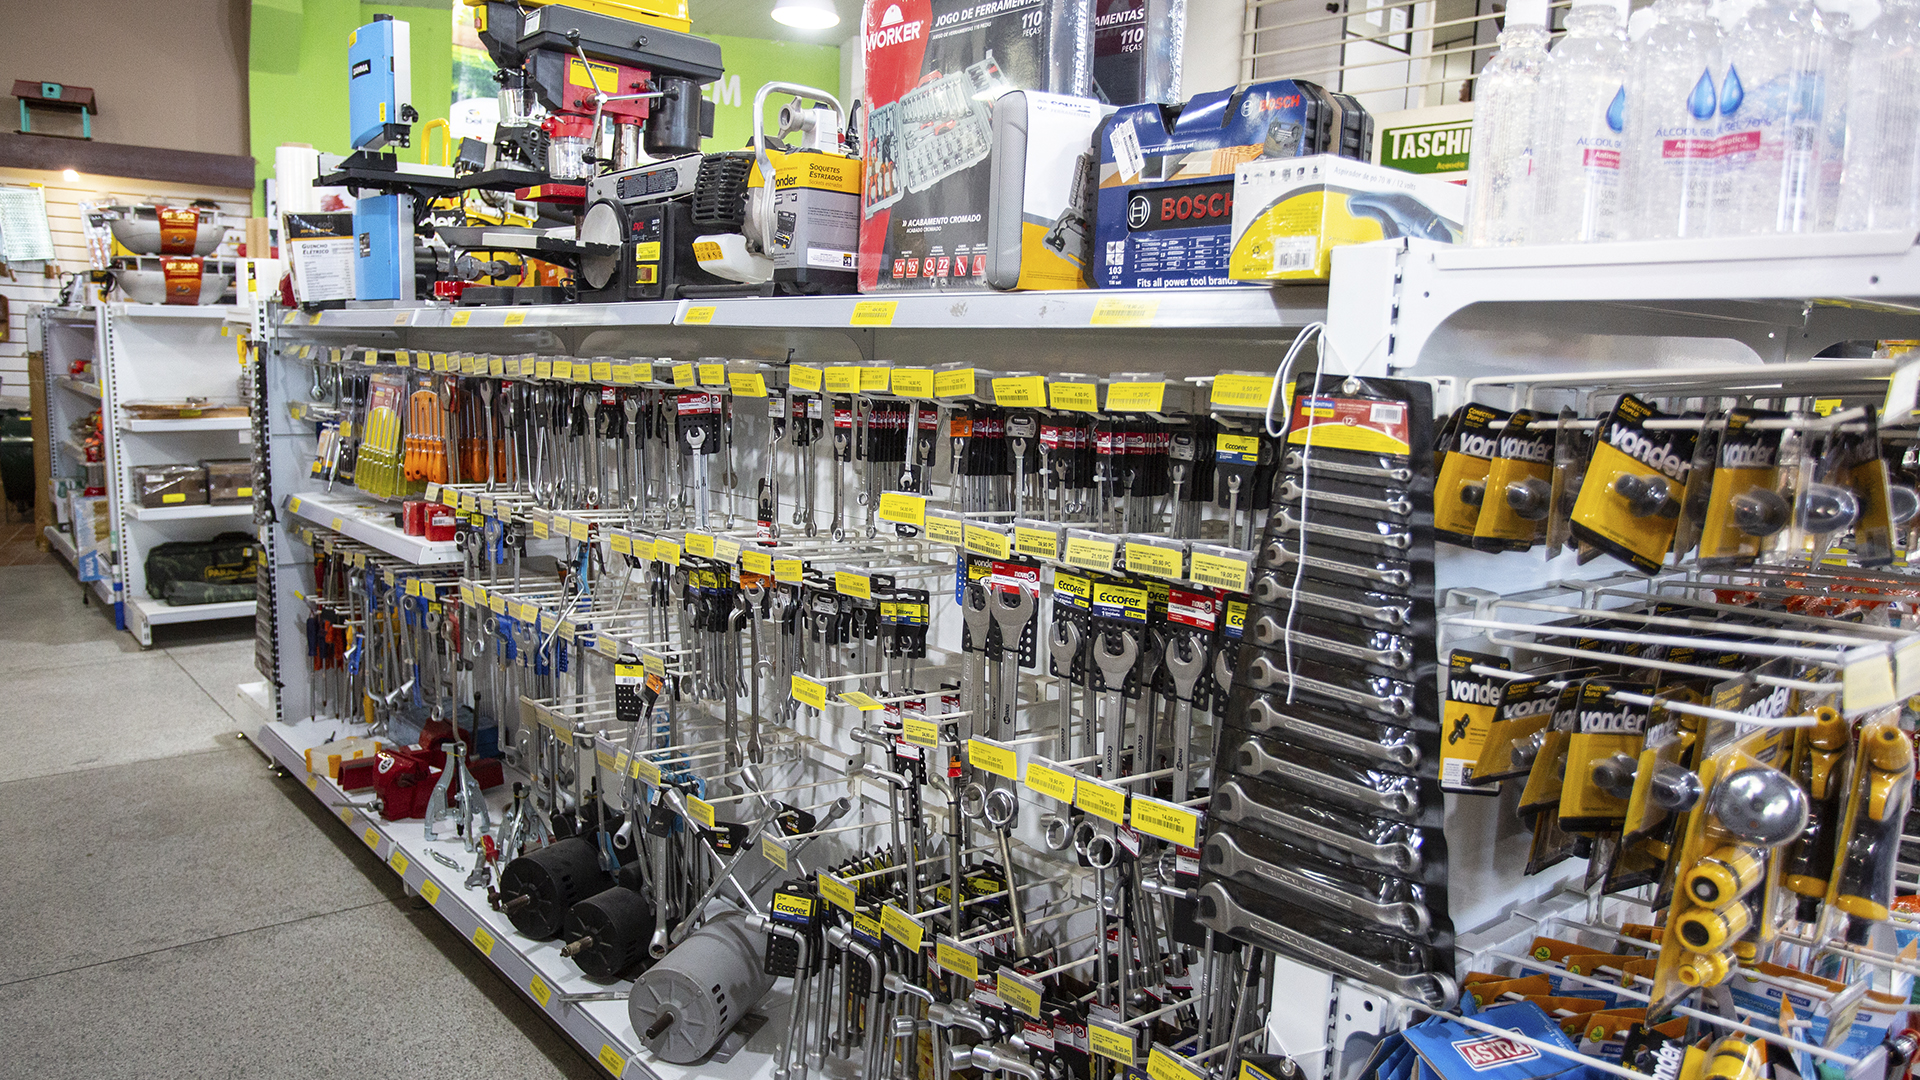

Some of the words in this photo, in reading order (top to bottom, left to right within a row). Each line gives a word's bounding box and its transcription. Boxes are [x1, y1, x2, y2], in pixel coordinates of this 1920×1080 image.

[935, 11, 960, 28] JOGO
[961, 9, 973, 22] DE
[1021, 10, 1043, 29] 110
[866, 20, 921, 51] WORKER
[1022, 26, 1041, 38] PEÇAS
[1120, 28, 1144, 45] 110
[1121, 43, 1142, 53] PEÇAS
[1259, 94, 1300, 112] BOSCH
[809, 163, 841, 174] SOQUETES
[809, 171, 843, 182] ESTRIADOS
[1334, 166, 1362, 178] Aspirador
[1362, 171, 1369, 180] de
[1378, 175, 1386, 184] 70
[1396, 180, 1404, 188] 12
[1404, 181, 1416, 191] volts
[1161, 193, 1234, 220] BOSCH
[908, 217, 948, 227] ACABAMENTO
[949, 213, 981, 224] CROMADO
[939, 260, 948, 269] 72
[1108, 266, 1122, 275] 103
[1137, 278, 1151, 288] Fits
[1152, 278, 1162, 287] all
[1164, 278, 1188, 288] power
[1190, 277, 1206, 286] tool
[1208, 275, 1238, 286] brands
[1468, 407, 1496, 419] CONECTOR
[1620, 403, 1639, 418] DUPLO
[1623, 397, 1652, 417] CONECTOR
[1466, 413, 1485, 423] DUPLO
[1500, 436, 1553, 460] vonder
[1610, 423, 1692, 480] vonder
[1100, 592, 1141, 607] Eccofer
[1580, 705, 1646, 733] vonder
[1174, 817, 1181, 825] PC
[1466, 1040, 1530, 1064] ASTRA
